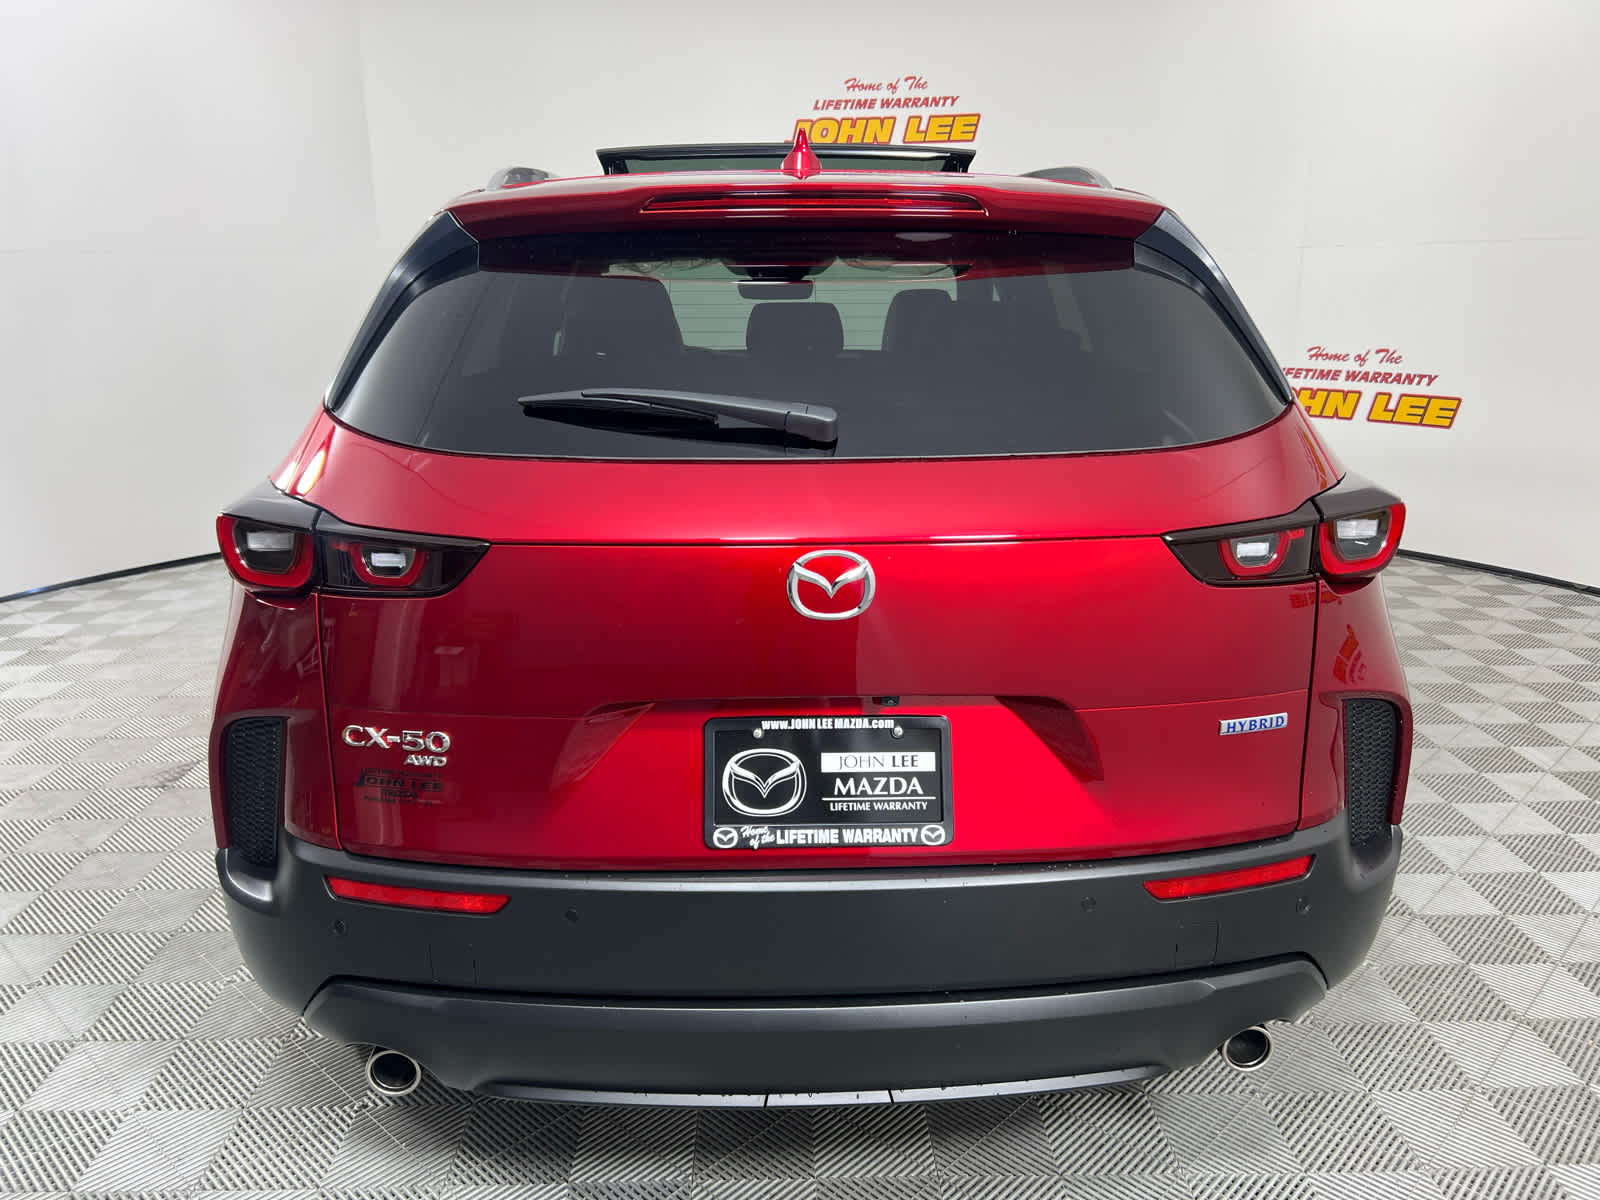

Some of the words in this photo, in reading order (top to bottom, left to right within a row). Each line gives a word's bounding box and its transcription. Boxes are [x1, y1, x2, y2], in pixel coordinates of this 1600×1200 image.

[844, 77, 883, 92] Home
[886, 78, 899, 94] of
[904, 76, 928, 90] The
[813, 98, 876, 111] LIFETIME
[880, 95, 960, 109] WARRANTY
[903, 113, 981, 144] LEE
[1307, 346, 1350, 362] Home
[1353, 349, 1369, 367] of
[1375, 348, 1403, 364] The
[1282, 368, 1342, 380] FETIME
[1345, 370, 1439, 386] WARRANTY
[1291, 387, 1362, 420] HN
[1366, 392, 1463, 429] LEE
[817, 718, 833, 729] LEE
[1226, 715, 1285, 734] HYBRID
[342, 724, 451, 753] CX-50
[403, 754, 448, 767] AWD
[839, 755, 884, 770] JOHN
[891, 755, 919, 768] LEE
[834, 776, 923, 795] MAZDA
[830, 801, 871, 811] LIFETIME
[873, 800, 928, 811] WARRANTY
[741, 825, 769, 838] Home
[776, 829, 839, 845] LIFETIME
[842, 828, 918, 844] WARRANTY
[749, 836, 760, 850] of
[761, 832, 776, 844] the
